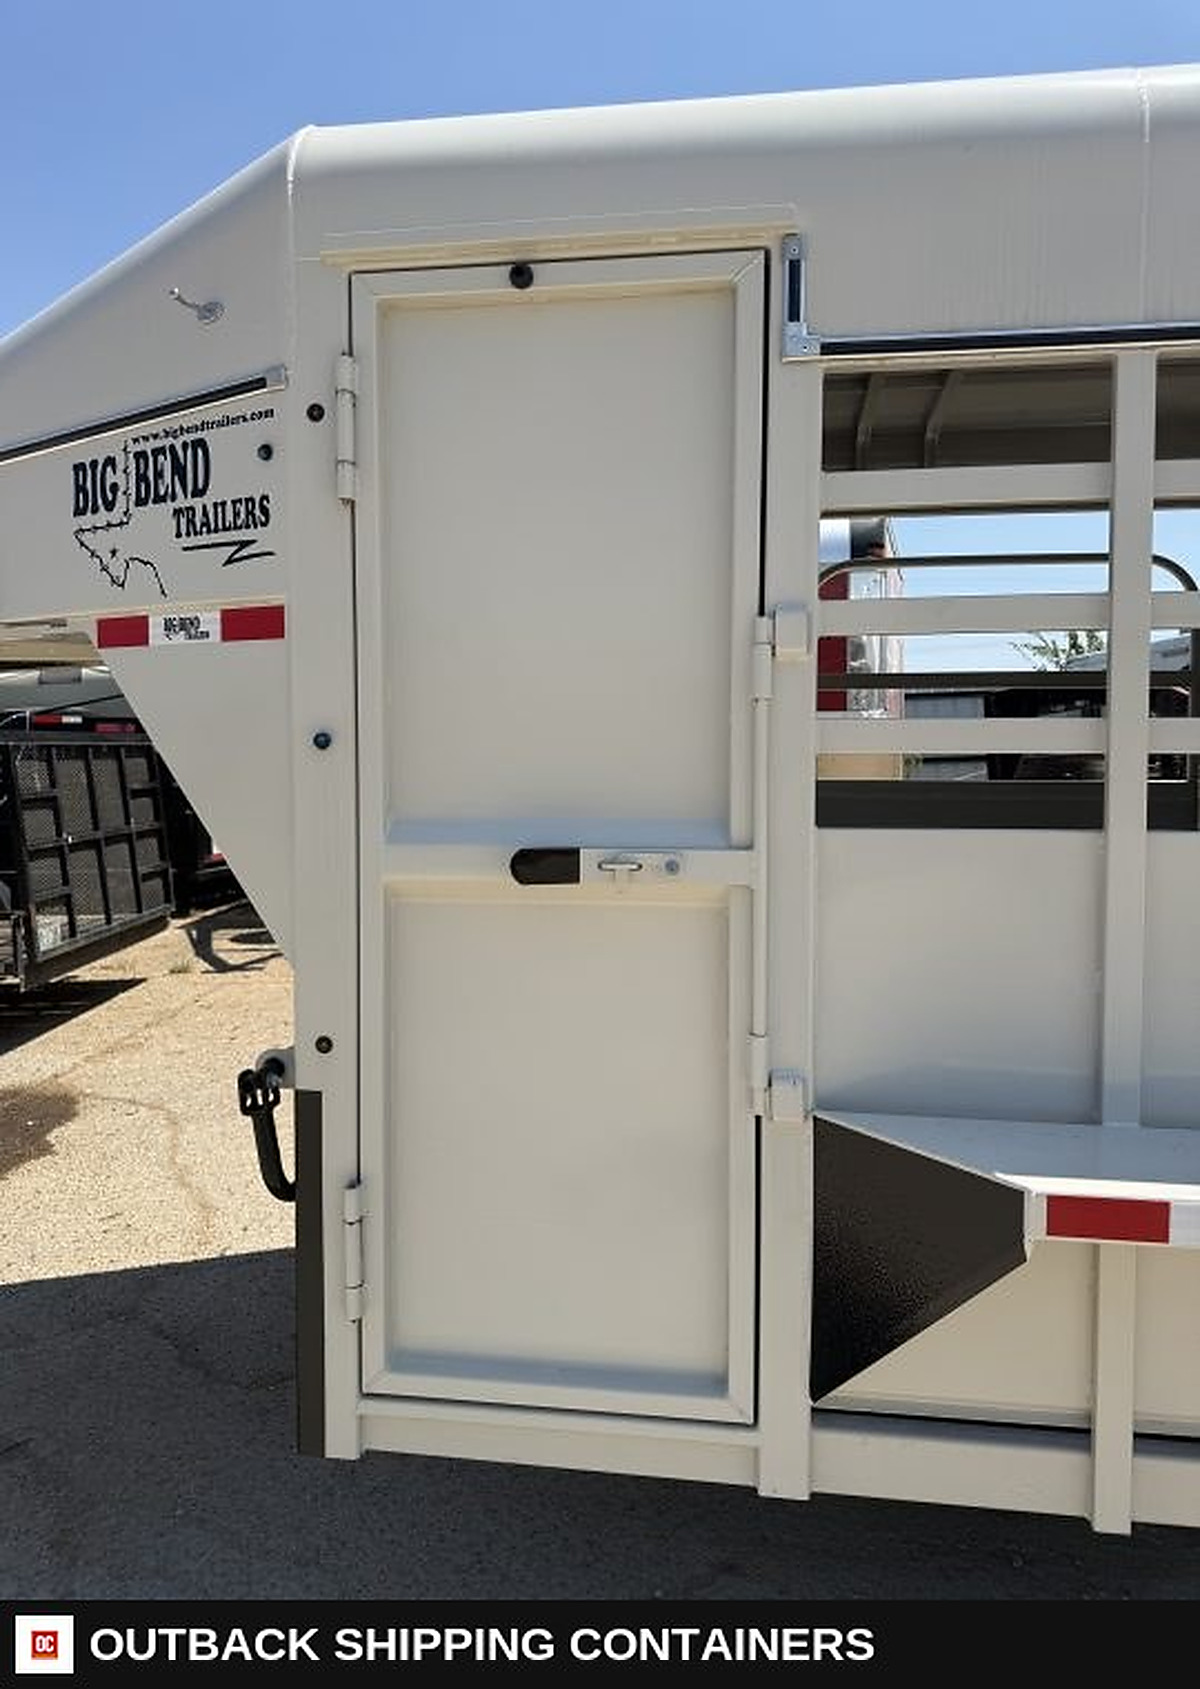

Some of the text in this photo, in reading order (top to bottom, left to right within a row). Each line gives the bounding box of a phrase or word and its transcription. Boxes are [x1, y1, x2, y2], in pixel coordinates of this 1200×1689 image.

[131, 408, 275, 445] www.bigbendtrailers.com
[72, 437, 211, 518] BIG BEND
[172, 494, 271, 539] TRAILERS
